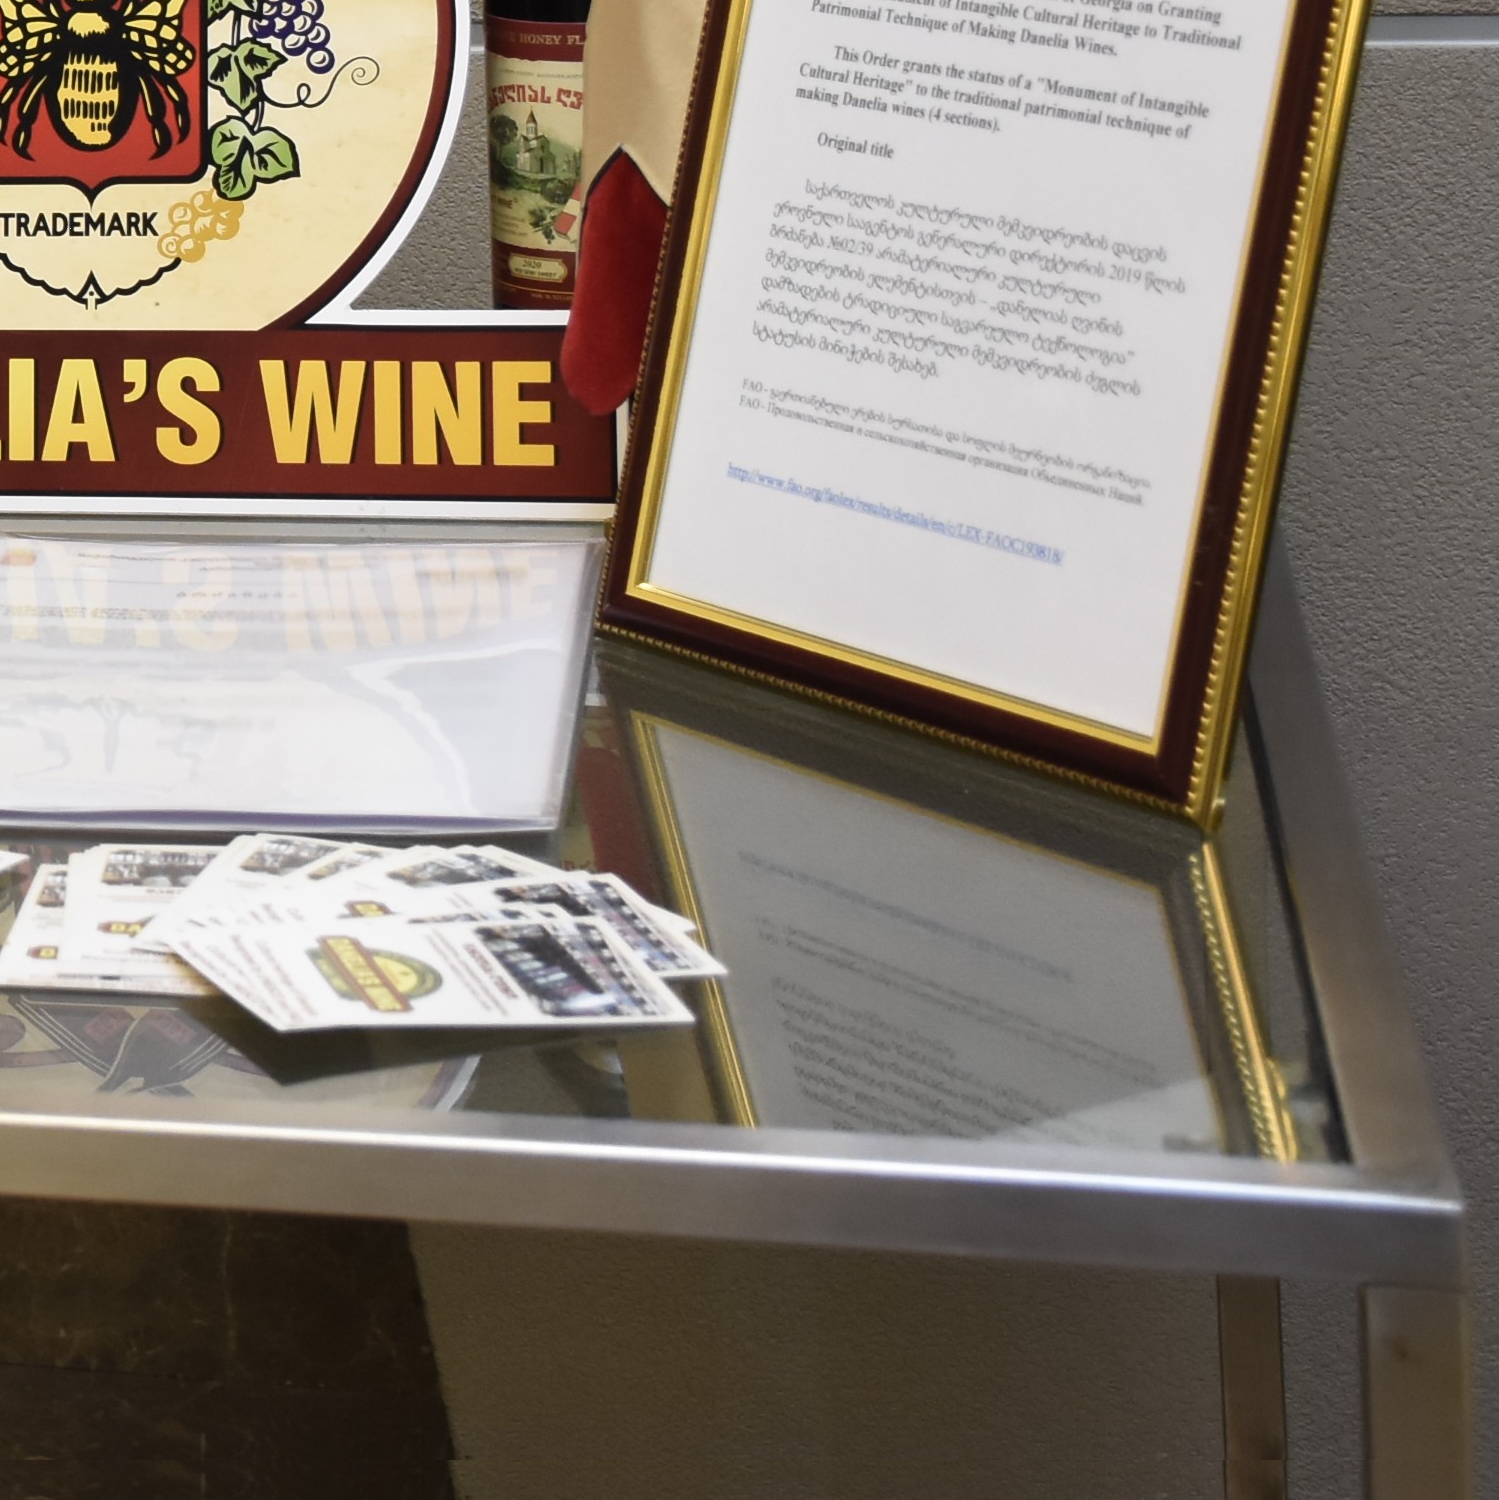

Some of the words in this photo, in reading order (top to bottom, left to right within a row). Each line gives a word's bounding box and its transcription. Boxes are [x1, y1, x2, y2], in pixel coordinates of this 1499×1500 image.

[519, 33, 562, 46] HONEY
[1022, 4, 1080, 28] Cultural
[1081, 12, 1141, 39] Heritage
[1143, 24, 1158, 39] to
[1163, 24, 1243, 51] Traditional
[816, 131, 869, 155] Original
[869, 141, 895, 160] title
[258, 358, 558, 467] WINE
